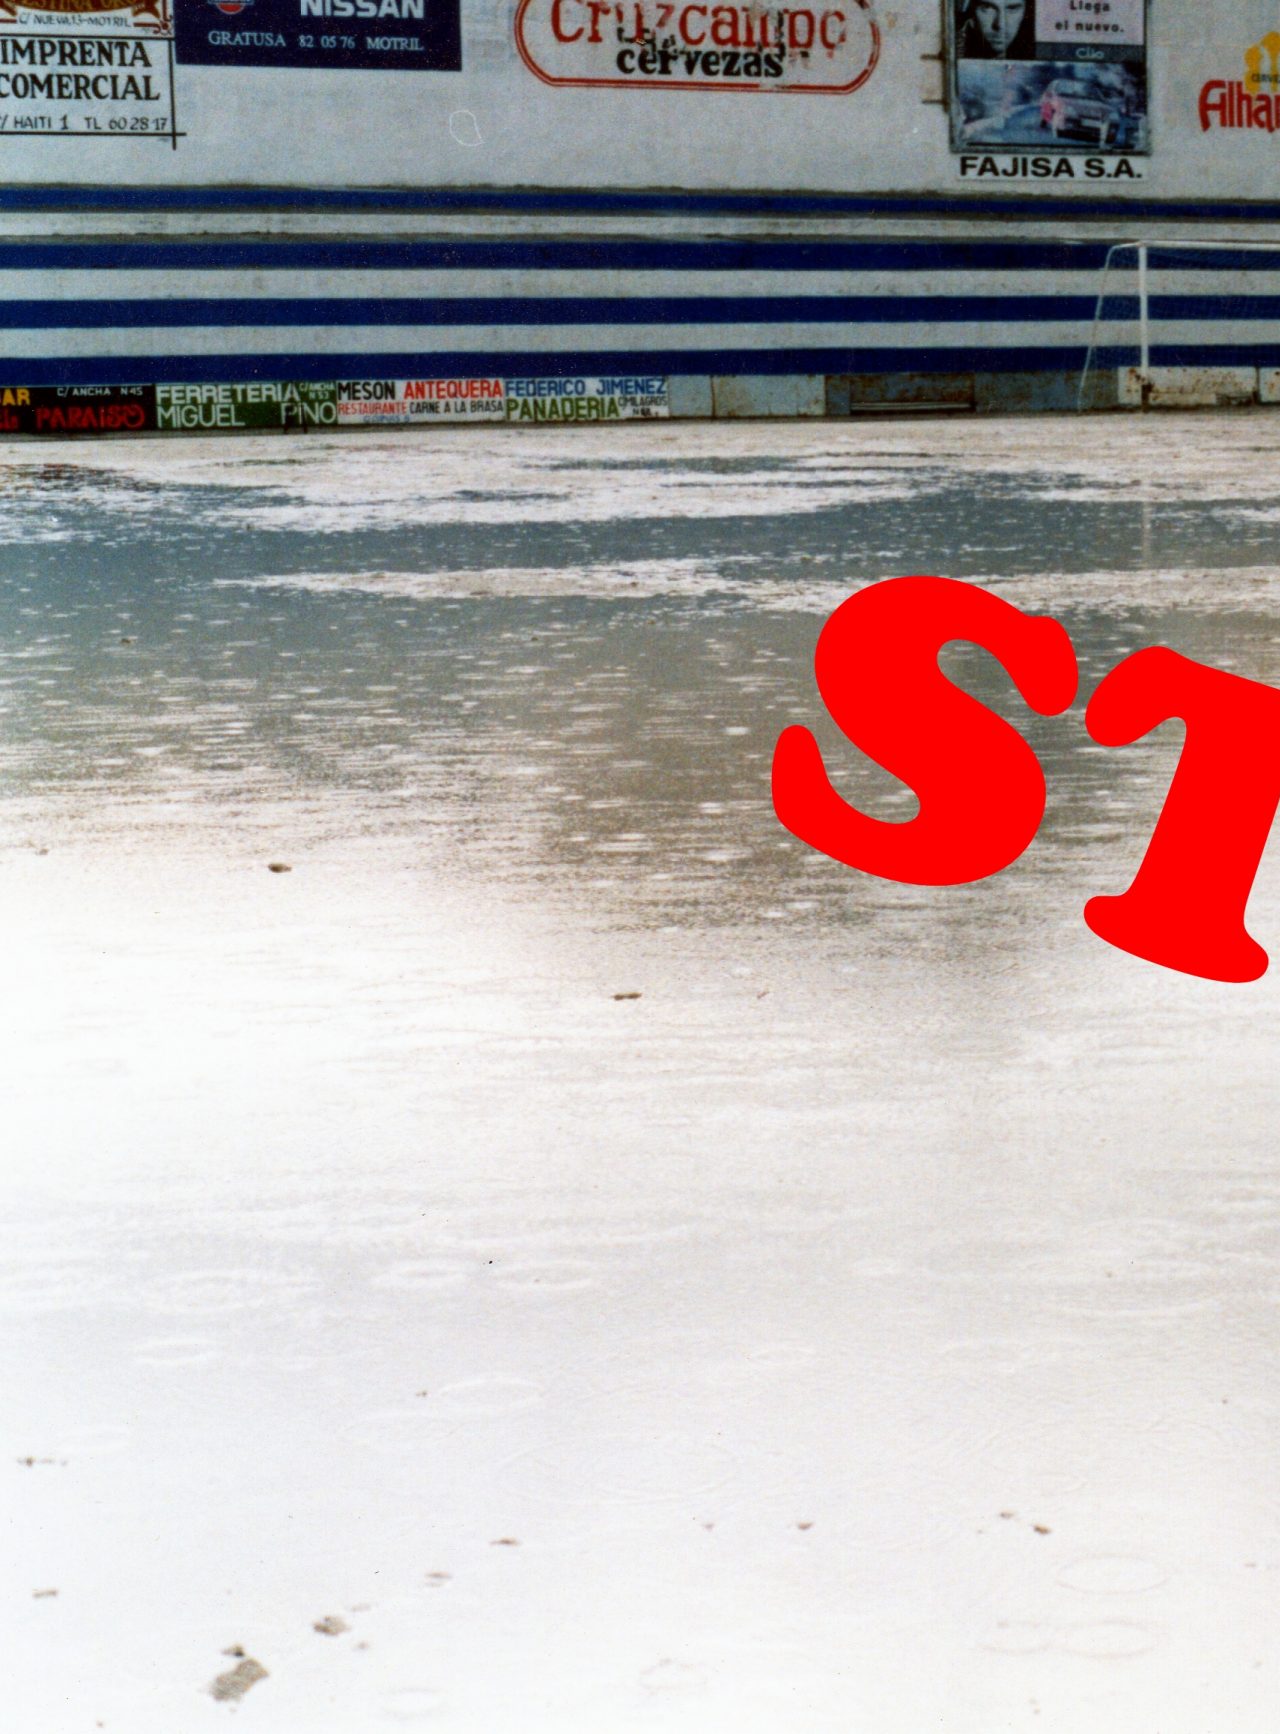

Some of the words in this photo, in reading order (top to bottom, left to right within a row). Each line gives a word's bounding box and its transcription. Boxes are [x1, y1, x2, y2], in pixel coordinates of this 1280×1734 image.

[301, 0, 425, 18] NISSAN
[1069, 0, 1111, 14] Llega
[207, 30, 286, 47] GRATUSA
[298, 35, 314, 48] 82
[321, 35, 336, 48] 05
[340, 36, 355, 49] 76
[366, 36, 424, 51] MOTRIL
[0, 39, 152, 67] IMPRENTA
[616, 48, 784, 77] cervezas
[0, 73, 161, 101] COMERCIAL
[14, 115, 51, 129] HAITI
[60, 114, 69, 130] 1
[84, 116, 102, 130] TL
[960, 156, 1075, 178] FAJISA
[1084, 158, 1142, 178] S.A.
[0, 387, 30, 405] AR
[72, 387, 111, 396] ANCHA
[156, 382, 300, 404] FERRETERIA
[338, 381, 395, 400] MESON
[404, 379, 503, 399] ANTEQUERA
[506, 379, 585, 397] FEDERICO
[596, 377, 666, 395] JIMENEZ
[157, 403, 245, 428] MIGUEL
[281, 401, 337, 424] PINO
[338, 401, 407, 415] RESTAURANTE
[410, 401, 440, 414] CARNE
[444, 401, 451, 413] A
[455, 401, 467, 413] LA
[470, 400, 503, 413] BRASA
[506, 395, 619, 421] PANADERIA
